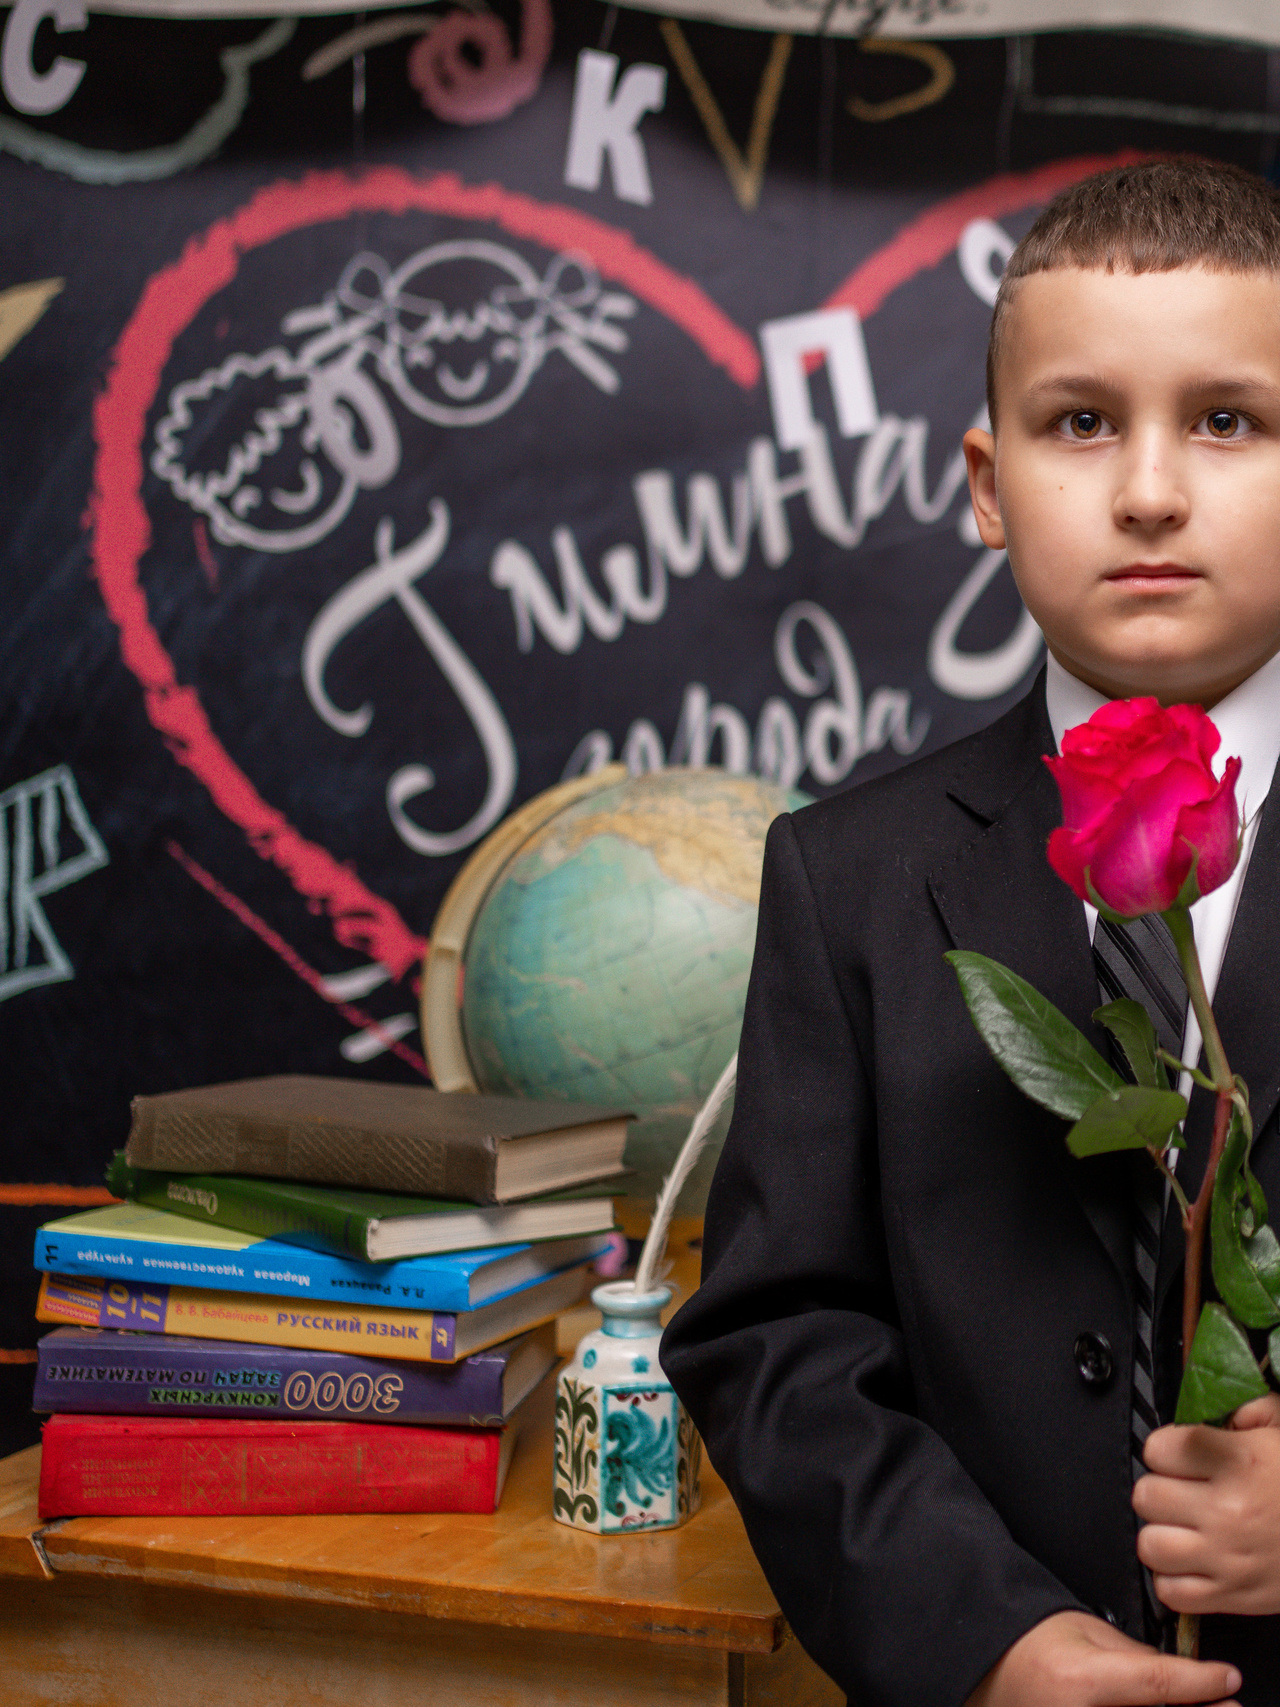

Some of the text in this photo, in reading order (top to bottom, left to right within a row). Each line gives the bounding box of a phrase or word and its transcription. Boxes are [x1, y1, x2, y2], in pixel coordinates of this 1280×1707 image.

[564, 47, 668, 206] К
[760, 306, 877, 451] П
[254, 1269, 311, 1287] Мировая
[277, 1313, 361, 1334] РУССКИЙ
[366, 1322, 420, 1340] ЯЗЫК
[47, 1365, 282, 1388] ЗАДАЧ ПО МАТЕМАТИКЕ
[149, 1370, 404, 1414] 3000 КОНКУРСНЫХ
